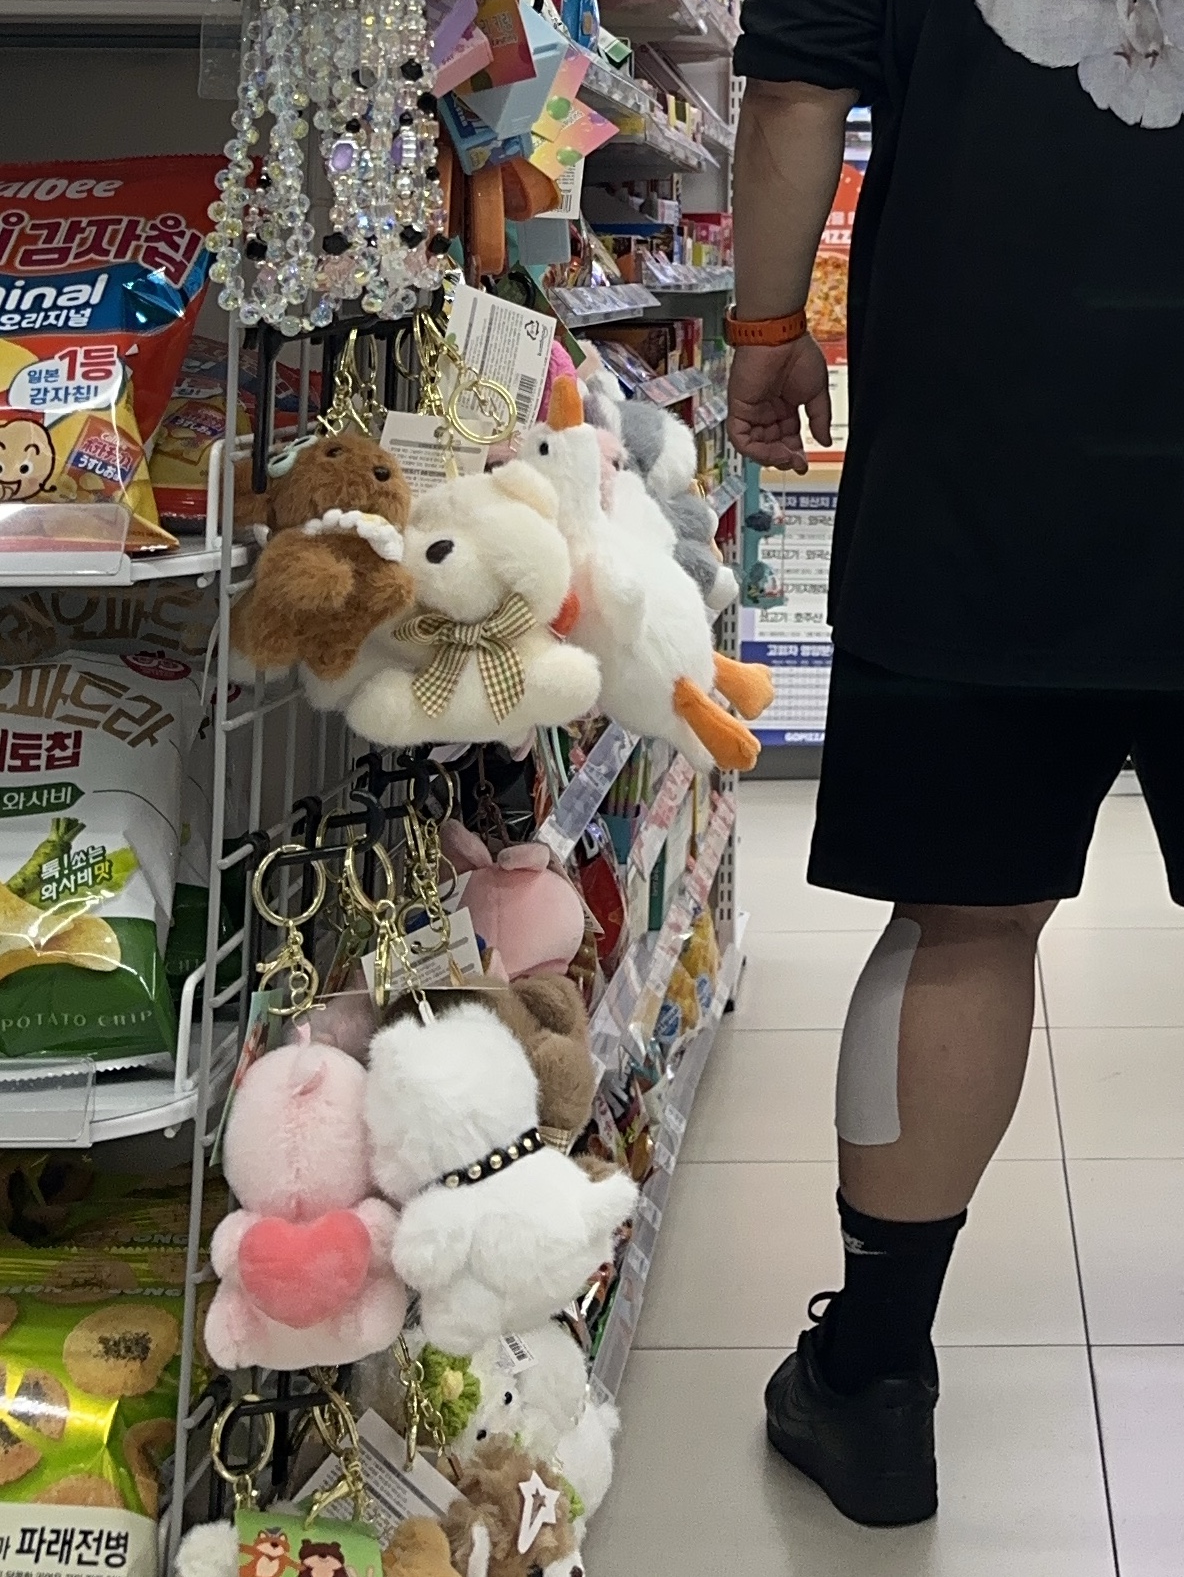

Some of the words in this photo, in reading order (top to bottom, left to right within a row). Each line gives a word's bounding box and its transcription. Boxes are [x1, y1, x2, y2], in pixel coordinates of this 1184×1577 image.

[1, 308, 92, 331] 오리지널
[27, 365, 60, 385] 일본
[55, 344, 118, 383] 1등
[29, 383, 99, 406] 감자칩!
[2, 787, 73, 811] 와사비
[40, 862, 113, 902] 와사비맛
[15, 1526, 130, 1569] 파래전병
